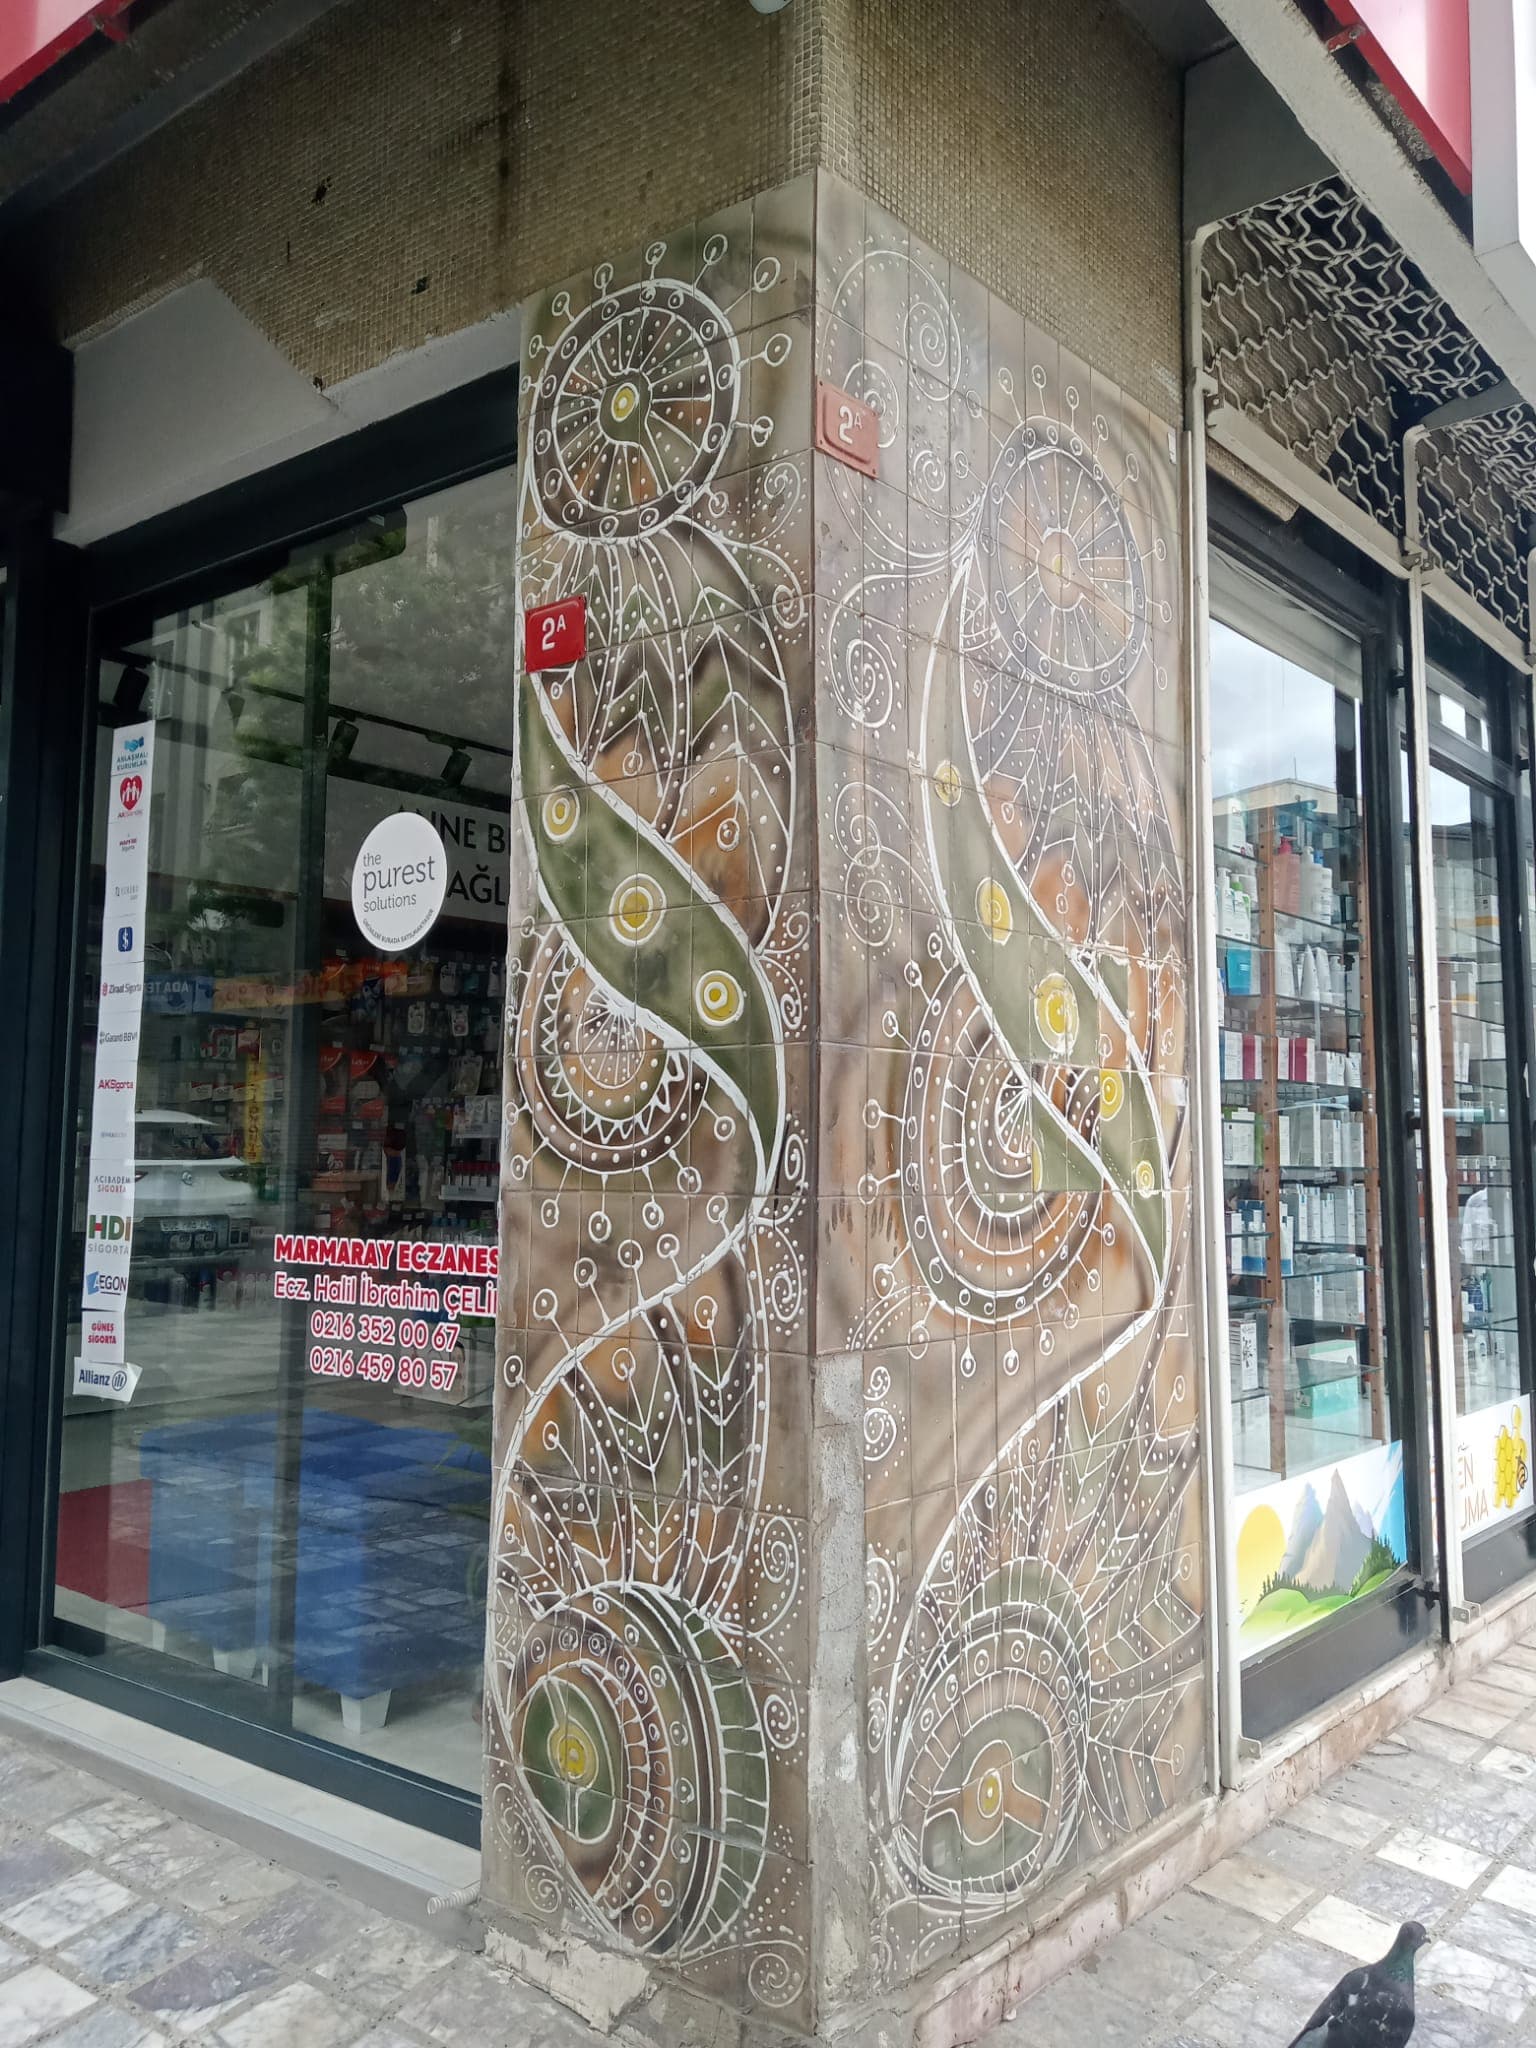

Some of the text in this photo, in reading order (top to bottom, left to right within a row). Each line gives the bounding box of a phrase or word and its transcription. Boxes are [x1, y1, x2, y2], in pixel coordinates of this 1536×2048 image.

[839, 405, 863, 445] 2A
[541, 614, 566, 651] 2A
[363, 853, 381, 867] the
[363, 856, 435, 899] purest
[363, 894, 417, 912] solutions
[109, 984, 125, 994] Ziraat
[275, 1235, 393, 1268] MARMARAY
[93, 1274, 127, 1291] AEGON
[275, 1272, 310, 1300] Ecz.
[314, 1275, 356, 1304] Halil
[361, 1272, 439, 1312] İbrahim
[91, 1321, 114, 1333] GÜNEŞ
[311, 1310, 459, 1352] 0216 352 00 67
[79, 1370, 110, 1386] Allianz
[310, 1346, 457, 1390] 0216 459 80 57
